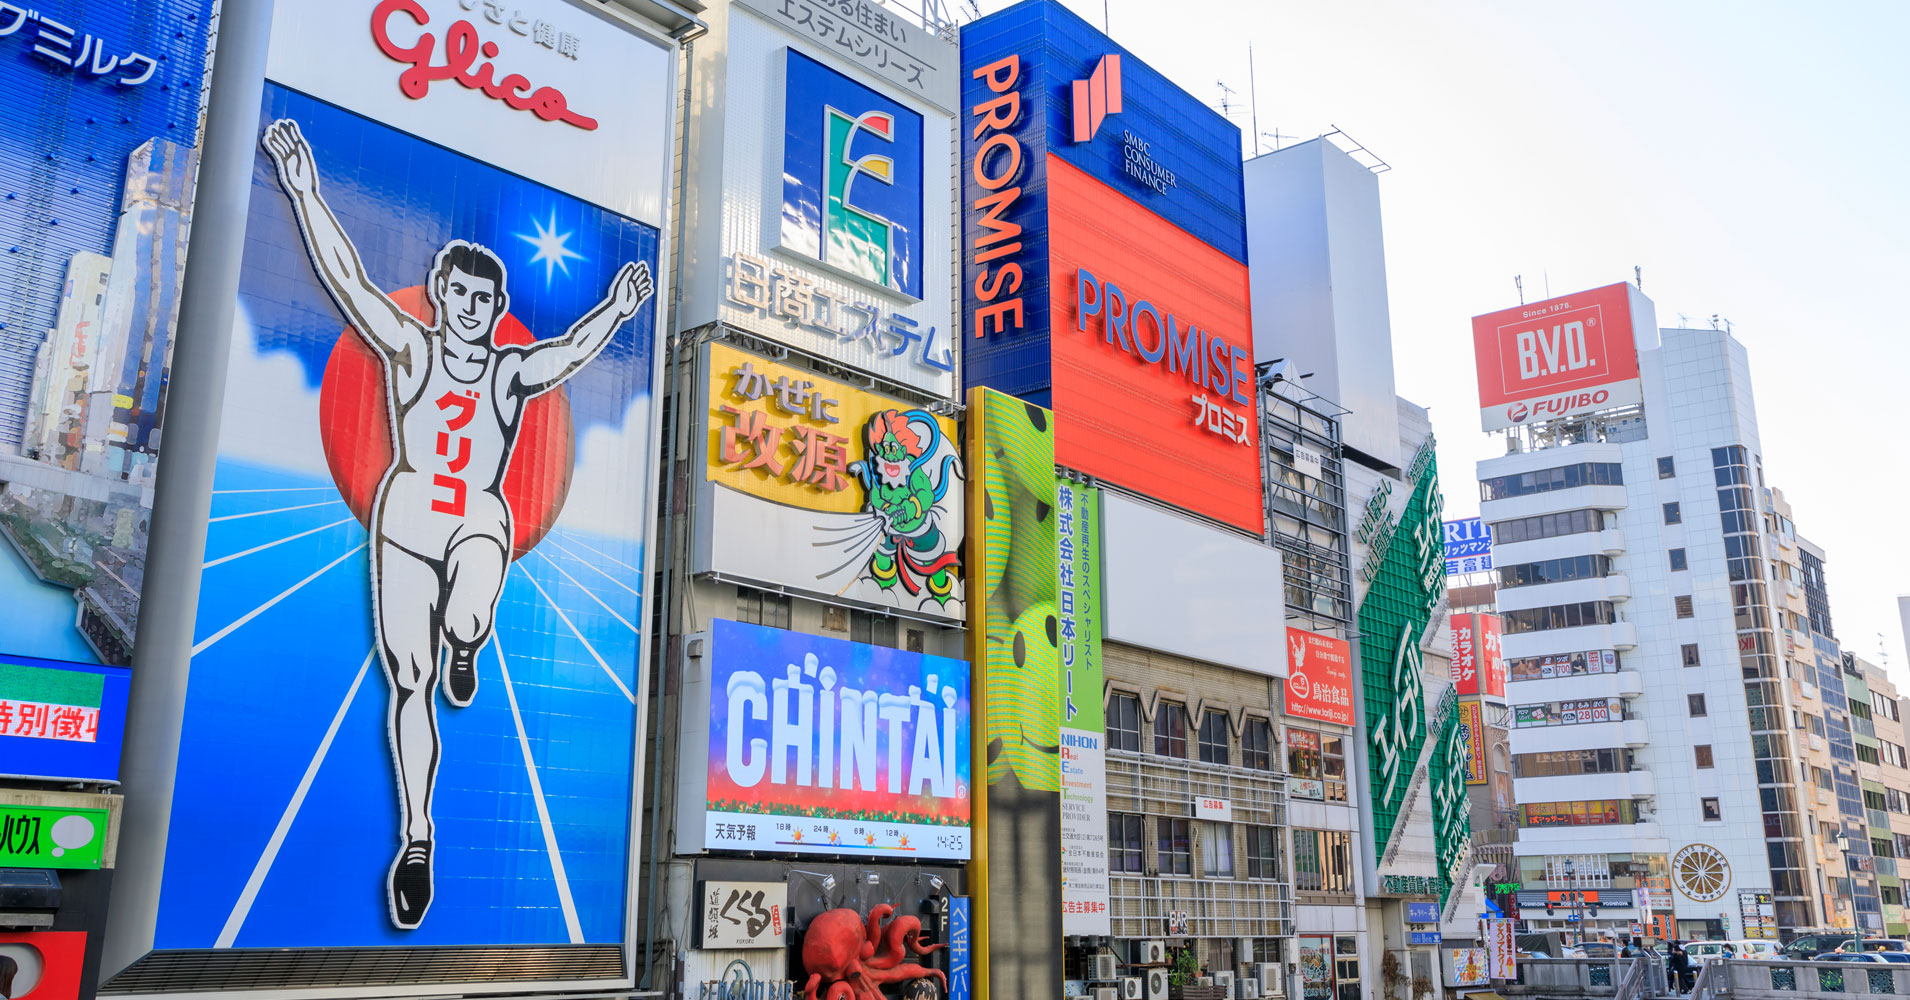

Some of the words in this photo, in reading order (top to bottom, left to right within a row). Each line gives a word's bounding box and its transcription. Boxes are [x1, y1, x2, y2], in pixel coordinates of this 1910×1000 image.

[777, 0, 924, 89] エステムシリーズ
[1124, 129, 1151, 157] SMBC
[1124, 145, 1177, 188] CONSUMER
[1125, 159, 1167, 196] FINANCE
[973, 54, 1024, 339] PROMISE
[732, 252, 954, 373] 日商エステム
[1523, 307, 1547, 318] Since
[1075, 267, 1249, 407] PROMISE
[1516, 320, 1596, 381] B.V.D.
[732, 361, 840, 424] かぜに
[1533, 390, 1609, 417] FUJIBO
[1191, 393, 1251, 447] プロミス
[431, 389, 481, 518] グリコ
[720, 404, 850, 492] 改源
[1058, 485, 1078, 722] 株式会社日本リート
[1459, 626, 1476, 681] カラオケ
[1061, 733, 1098, 750] NIHON
[1061, 747, 1078, 761] Real
[1061, 774, 1092, 789] Investment
[1062, 761, 1084, 775] Estate
[1061, 787, 1094, 804] Technology
[1062, 803, 1086, 812] SERVICE
[776, 822, 791, 832] 18時
[813, 825, 829, 834] 24時
[1062, 812, 1091, 822] PROVIDER
[0, 814, 41, 856] ハウス
[715, 823, 757, 841] 天気予報
[885, 829, 899, 837] 12時
[937, 834, 963, 850] 14:25
[1674, 846, 1695, 869] FRUITS
